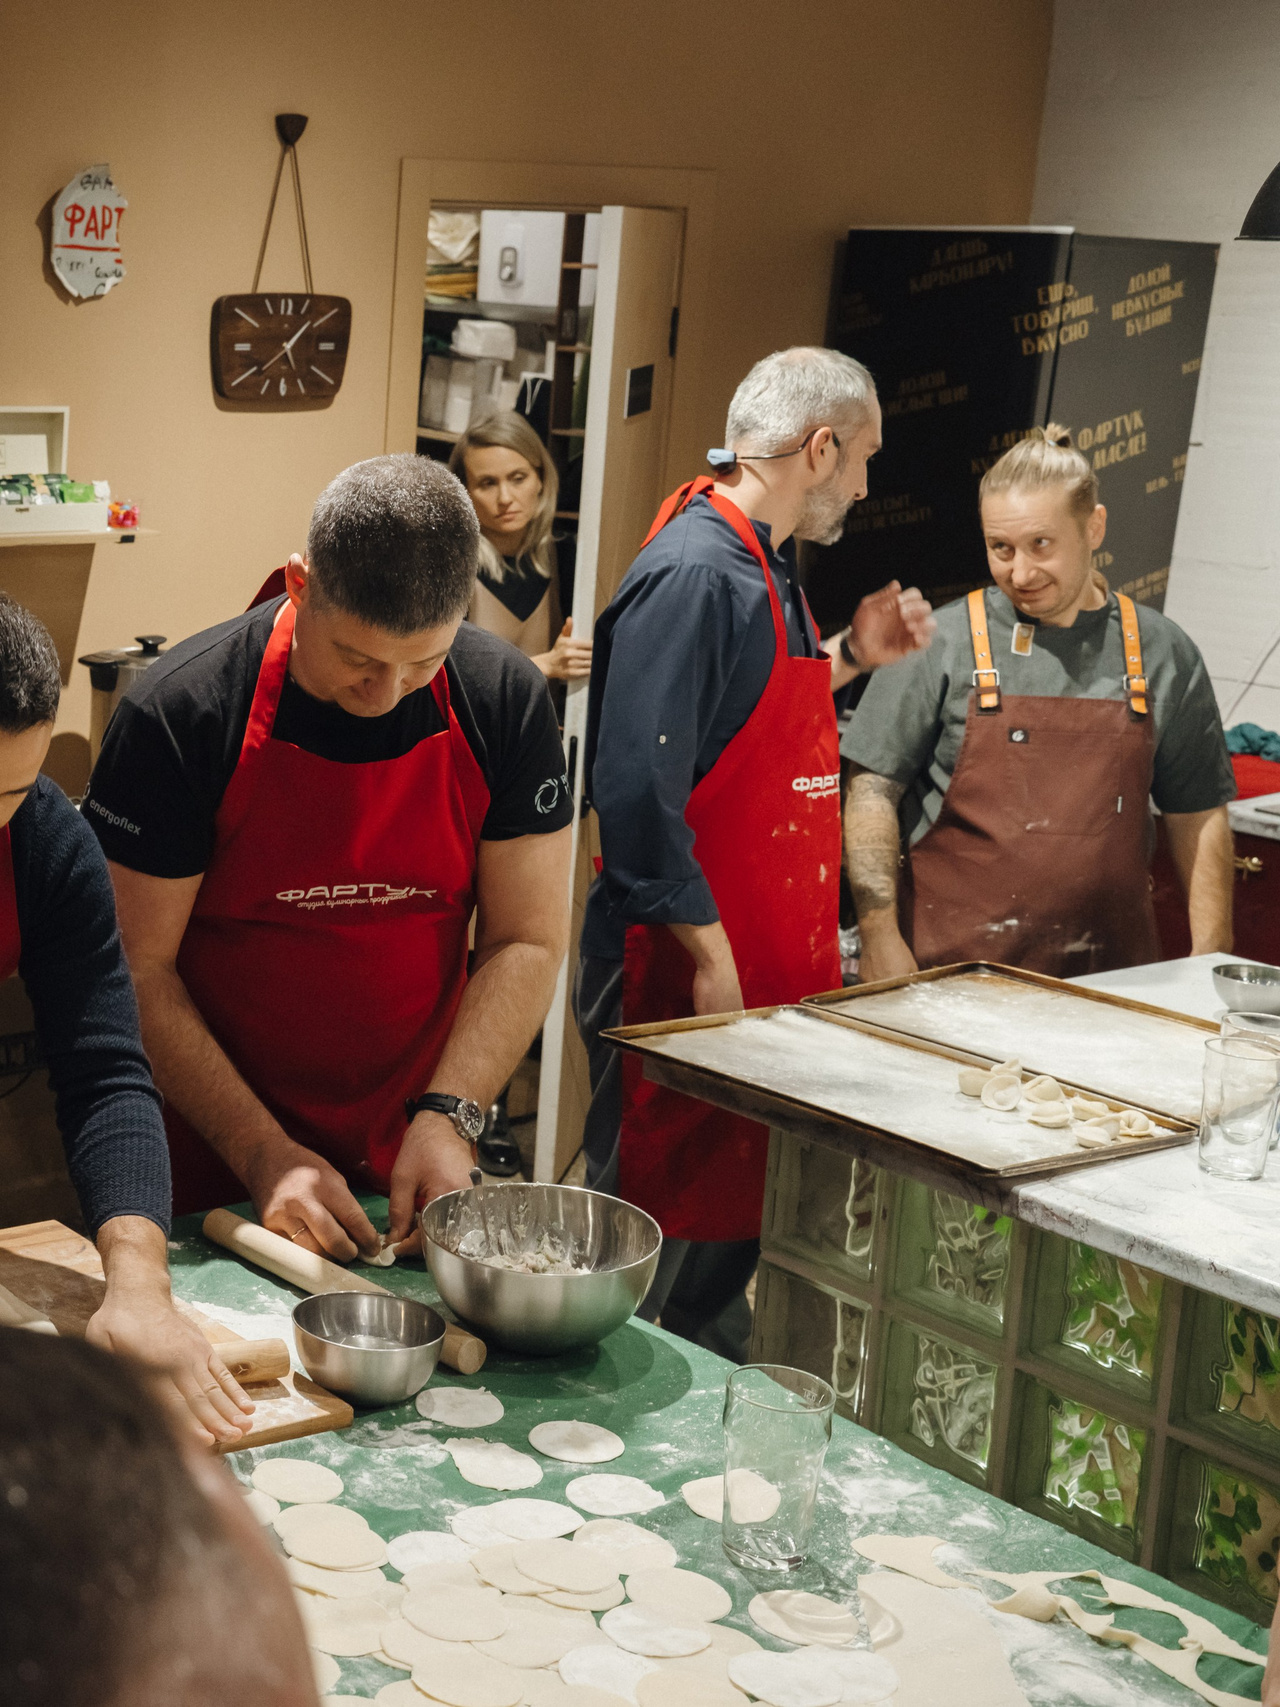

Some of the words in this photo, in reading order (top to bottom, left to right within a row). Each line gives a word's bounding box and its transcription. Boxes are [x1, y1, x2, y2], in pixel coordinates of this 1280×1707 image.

[1127, 263, 1171, 295] ДОЛОЙ
[280, 298, 293, 316] 12
[1111, 281, 1184, 321] НЕВКУСНЫЕ
[1021, 320, 1089, 356] ВКУСНО
[279, 377, 287, 397] 6
[1078, 409, 1144, 451] ФАРТУК
[89, 799, 142, 835] energoflex
[275, 883, 437, 903] ФАРТУК
[297, 900, 326, 911] студия
